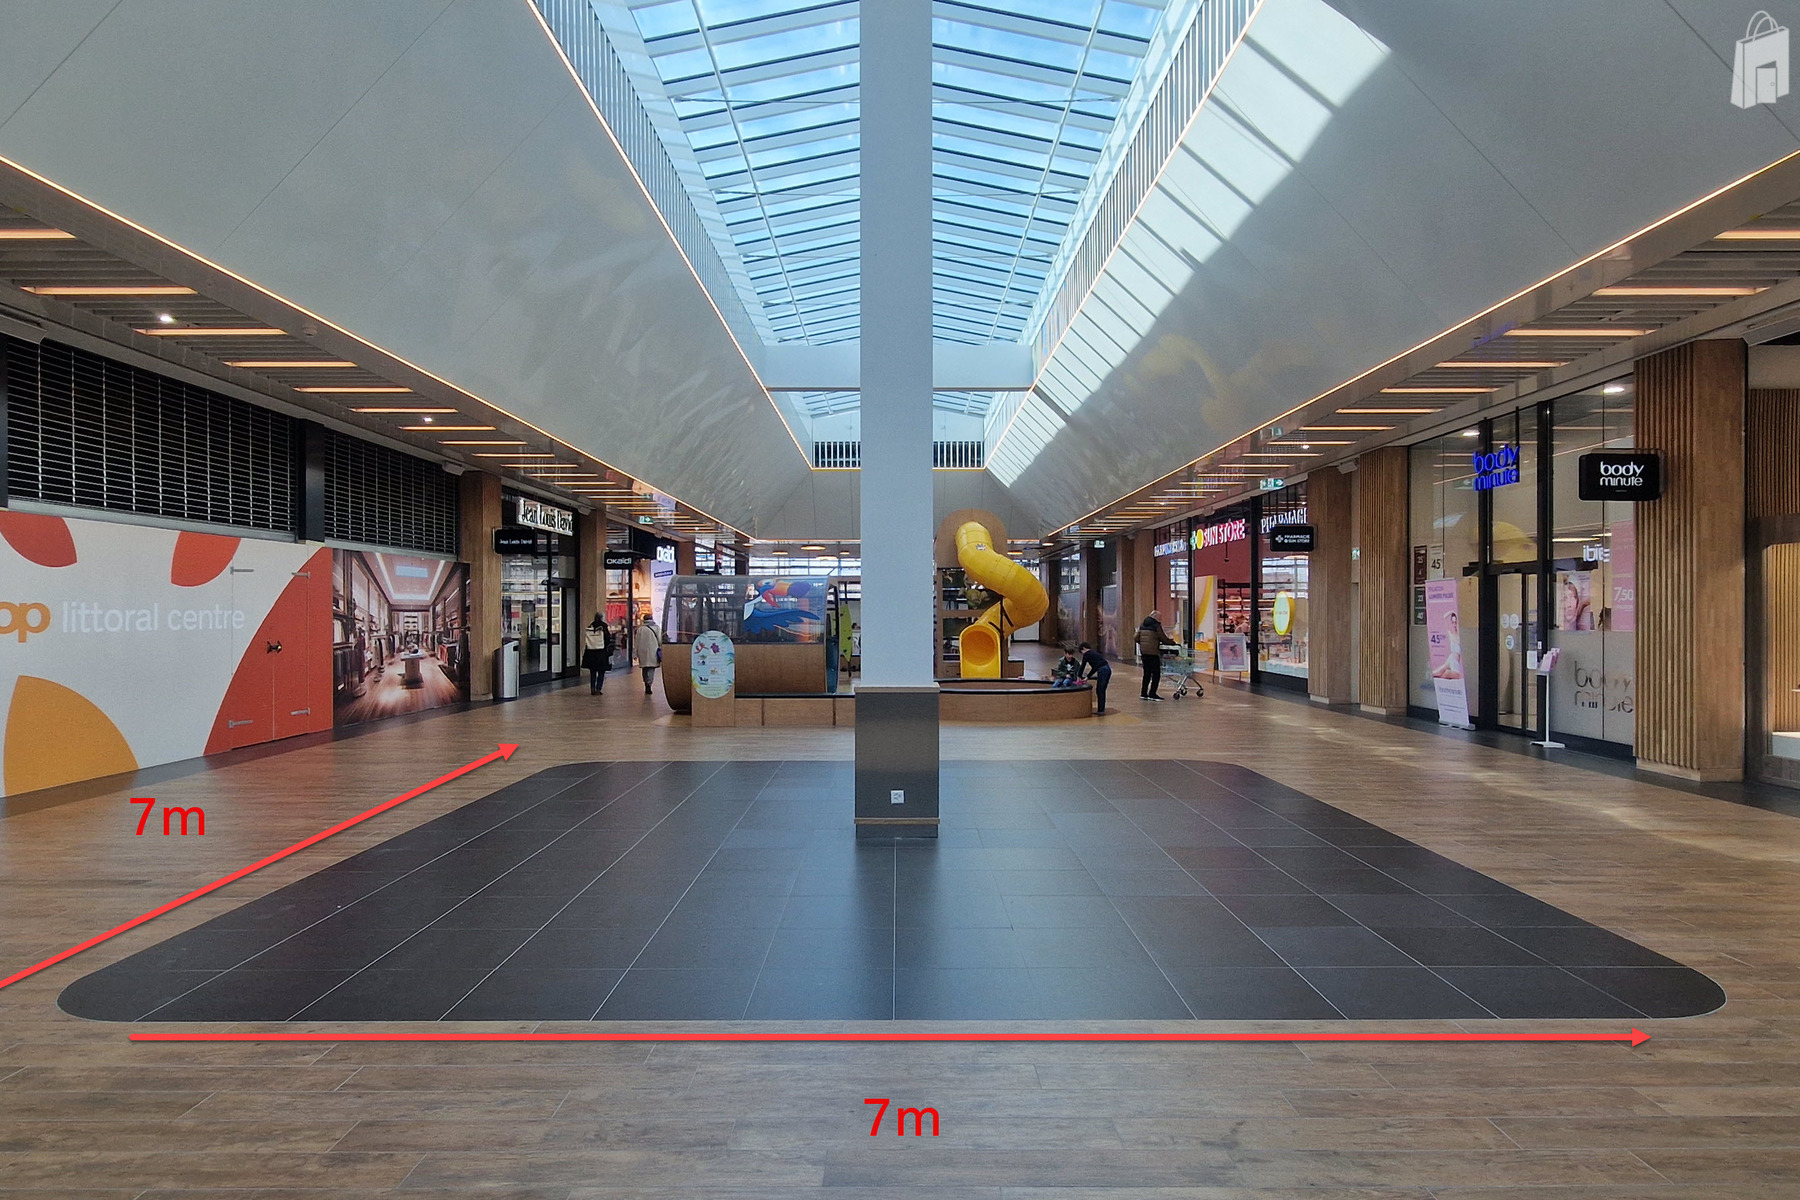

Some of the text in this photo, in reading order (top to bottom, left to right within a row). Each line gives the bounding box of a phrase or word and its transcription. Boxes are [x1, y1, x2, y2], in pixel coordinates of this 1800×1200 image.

[1473, 445, 1520, 475] body
[1600, 461, 1644, 477] body
[1474, 467, 1520, 491] minute
[1600, 476, 1643, 486] minute
[521, 500, 573, 533] Jean Louis David
[1203, 519, 1245, 547] SUN STORE
[62, 602, 159, 633] littoral
[167, 604, 245, 630] centre
